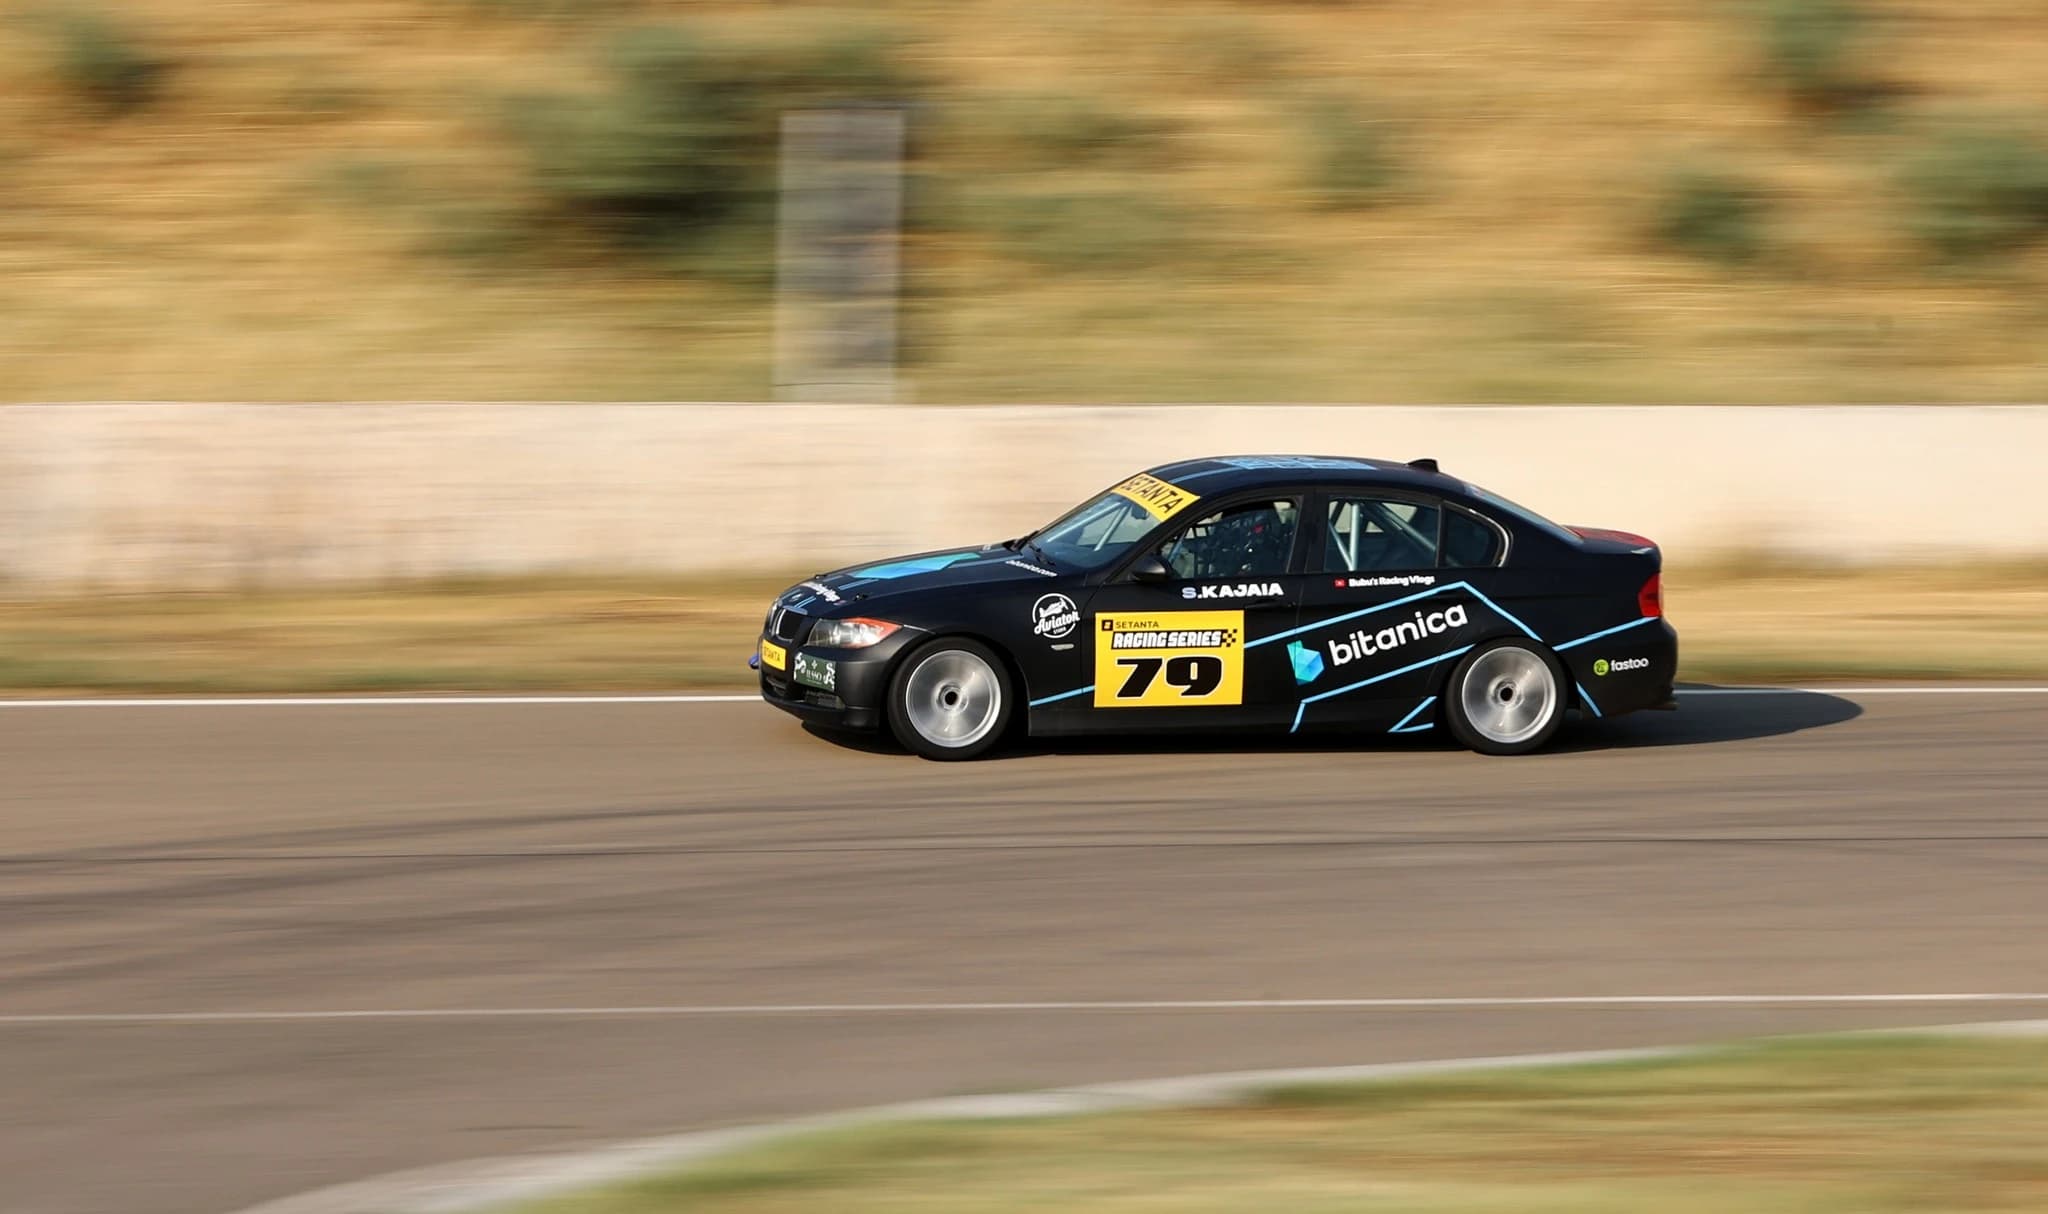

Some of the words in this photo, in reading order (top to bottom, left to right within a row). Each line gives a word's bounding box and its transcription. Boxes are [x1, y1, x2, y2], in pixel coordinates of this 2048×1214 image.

[1120, 476, 1184, 514] SETANTA
[1348, 577, 1379, 587] Bubu's
[1379, 576, 1409, 587] Racing
[1408, 575, 1436, 586] Vlogs
[1182, 583, 1284, 599] S.KAJAIA
[1115, 621, 1160, 629] SETANTA
[1113, 632, 1167, 649] RACING
[1168, 630, 1222, 648] SERIES
[1328, 604, 1468, 667] bitanica
[1611, 658, 1649, 671] fastoo
[1115, 654, 1224, 699] 79
